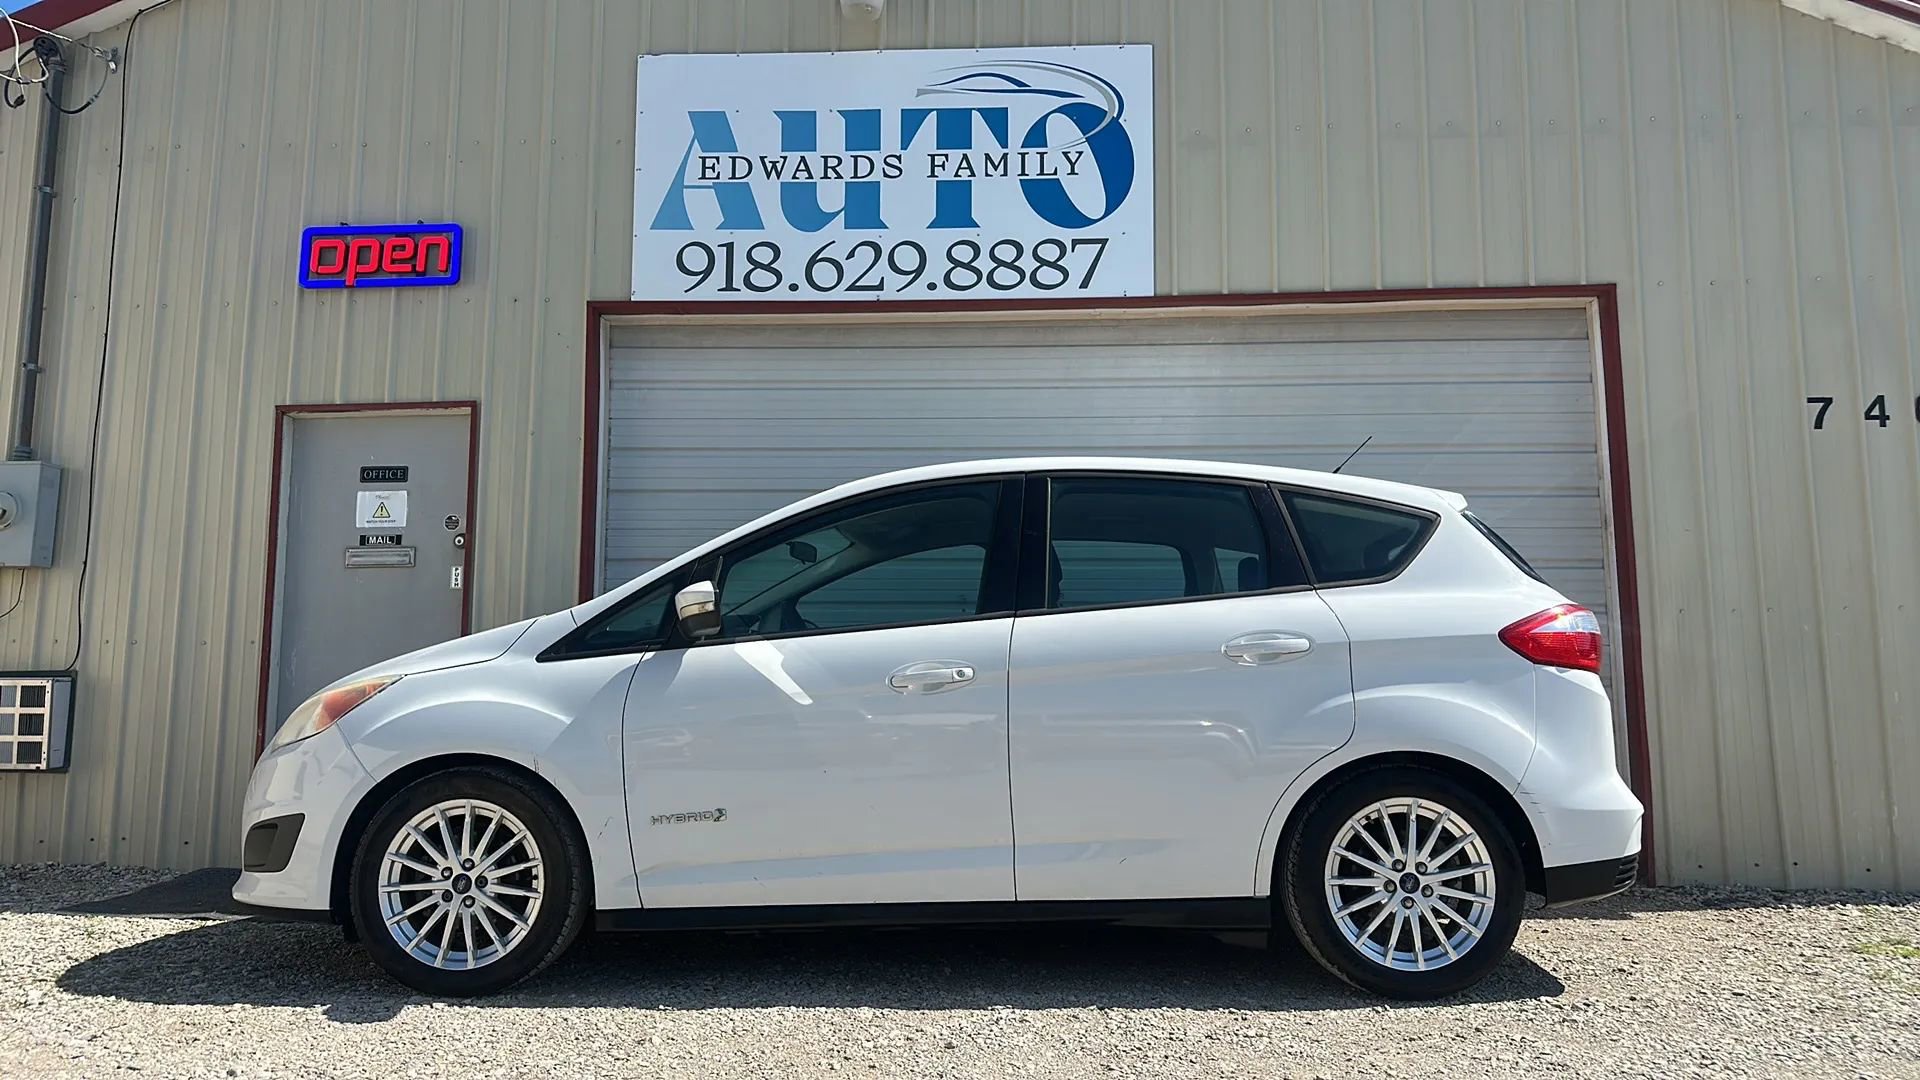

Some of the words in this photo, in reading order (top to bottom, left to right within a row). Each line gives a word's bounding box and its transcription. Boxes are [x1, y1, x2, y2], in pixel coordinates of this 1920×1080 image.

[650, 102, 1135, 232] AUTO
[698, 154, 903, 180] EDWARDS
[927, 151, 1084, 179] FAMILY
[310, 236, 449, 286] open
[676, 238, 1109, 293] 918.629.8887
[1807, 394, 1920, 429] 74
[364, 469, 404, 479] OFFICE
[368, 536, 392, 544] MAIL
[650, 811, 714, 825] HYBRID
